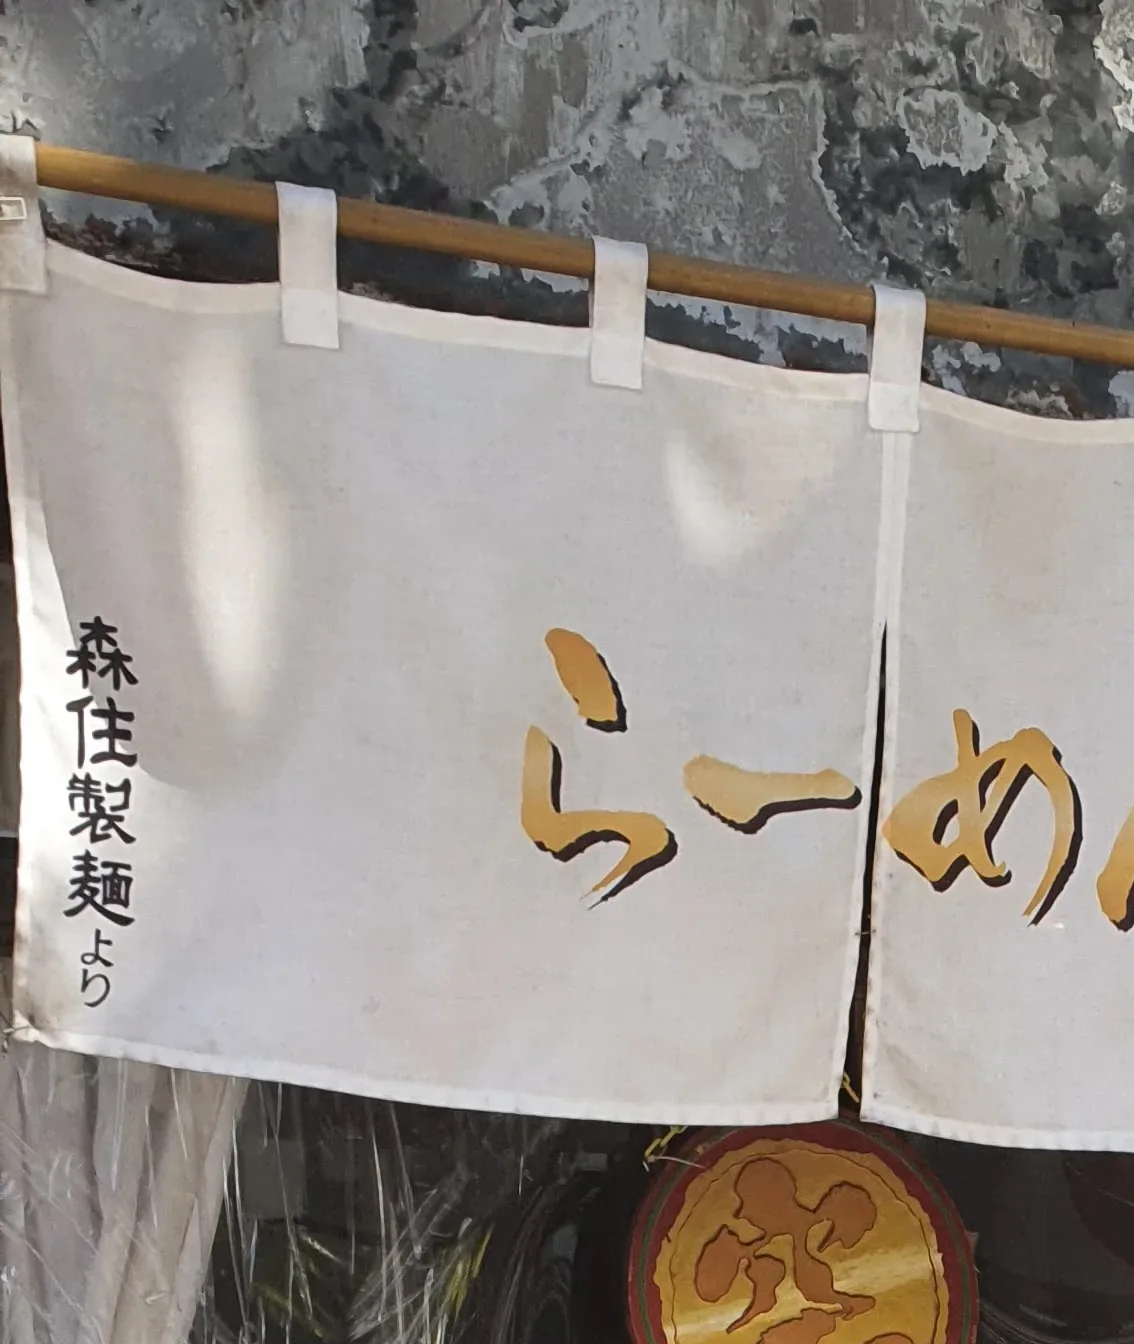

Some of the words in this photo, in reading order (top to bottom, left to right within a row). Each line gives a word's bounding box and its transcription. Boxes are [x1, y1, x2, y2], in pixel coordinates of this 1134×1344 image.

[64, 616, 139, 1009] 森住製麺より
